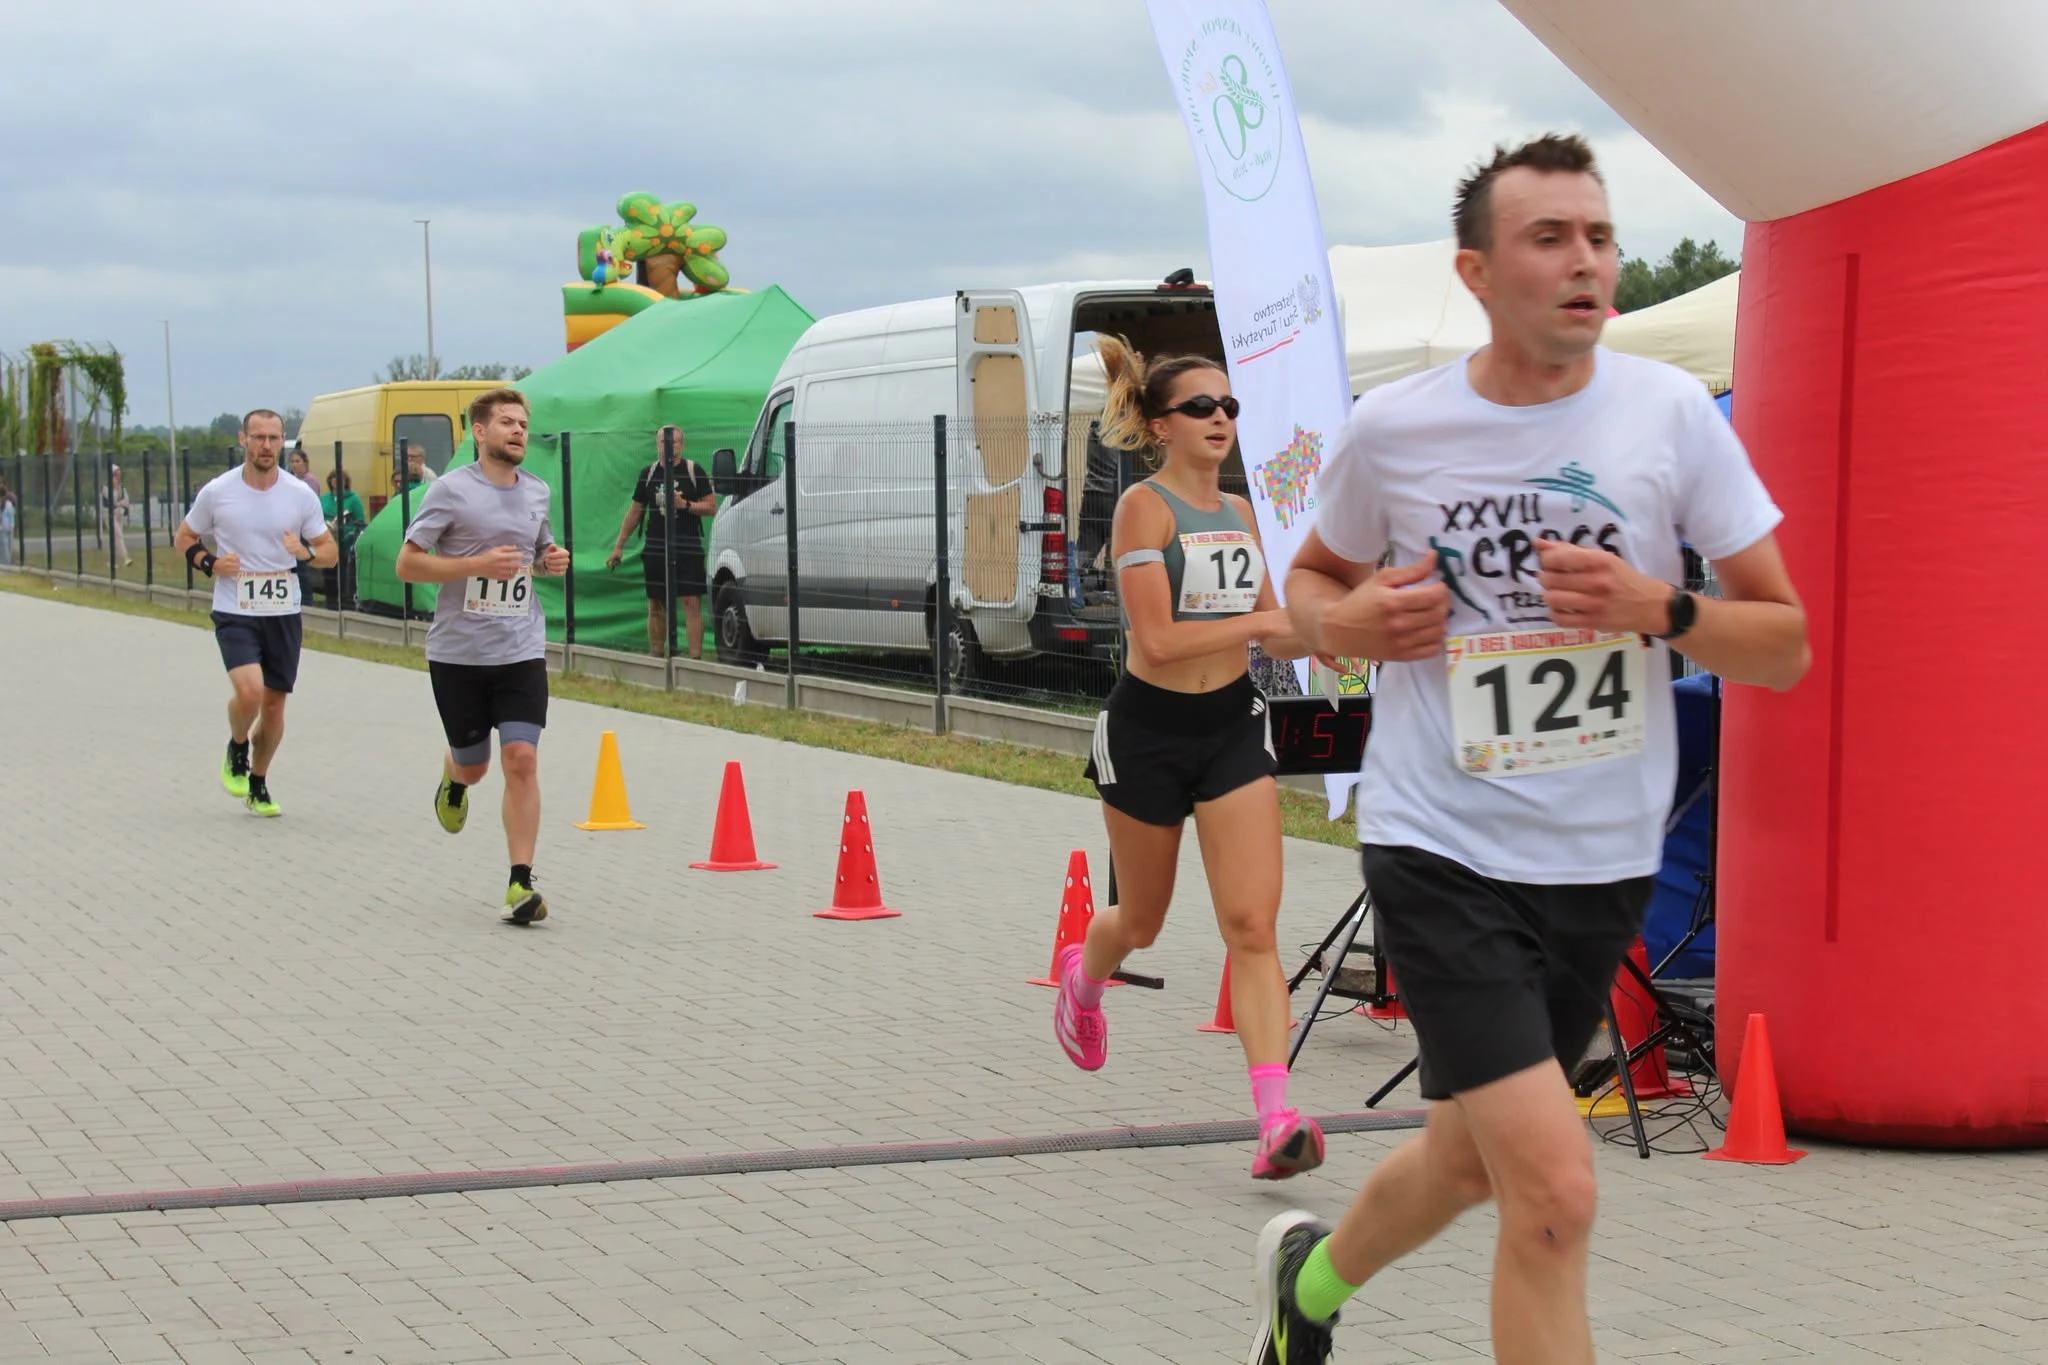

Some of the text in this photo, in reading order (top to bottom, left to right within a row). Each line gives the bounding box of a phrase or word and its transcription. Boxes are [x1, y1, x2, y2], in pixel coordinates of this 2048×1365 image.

[1440, 492, 1543, 533] XXVII
[476, 575, 527, 602] 116
[1210, 547, 1254, 590] 12
[244, 579, 289, 600] 145
[1474, 650, 1632, 736] 124
